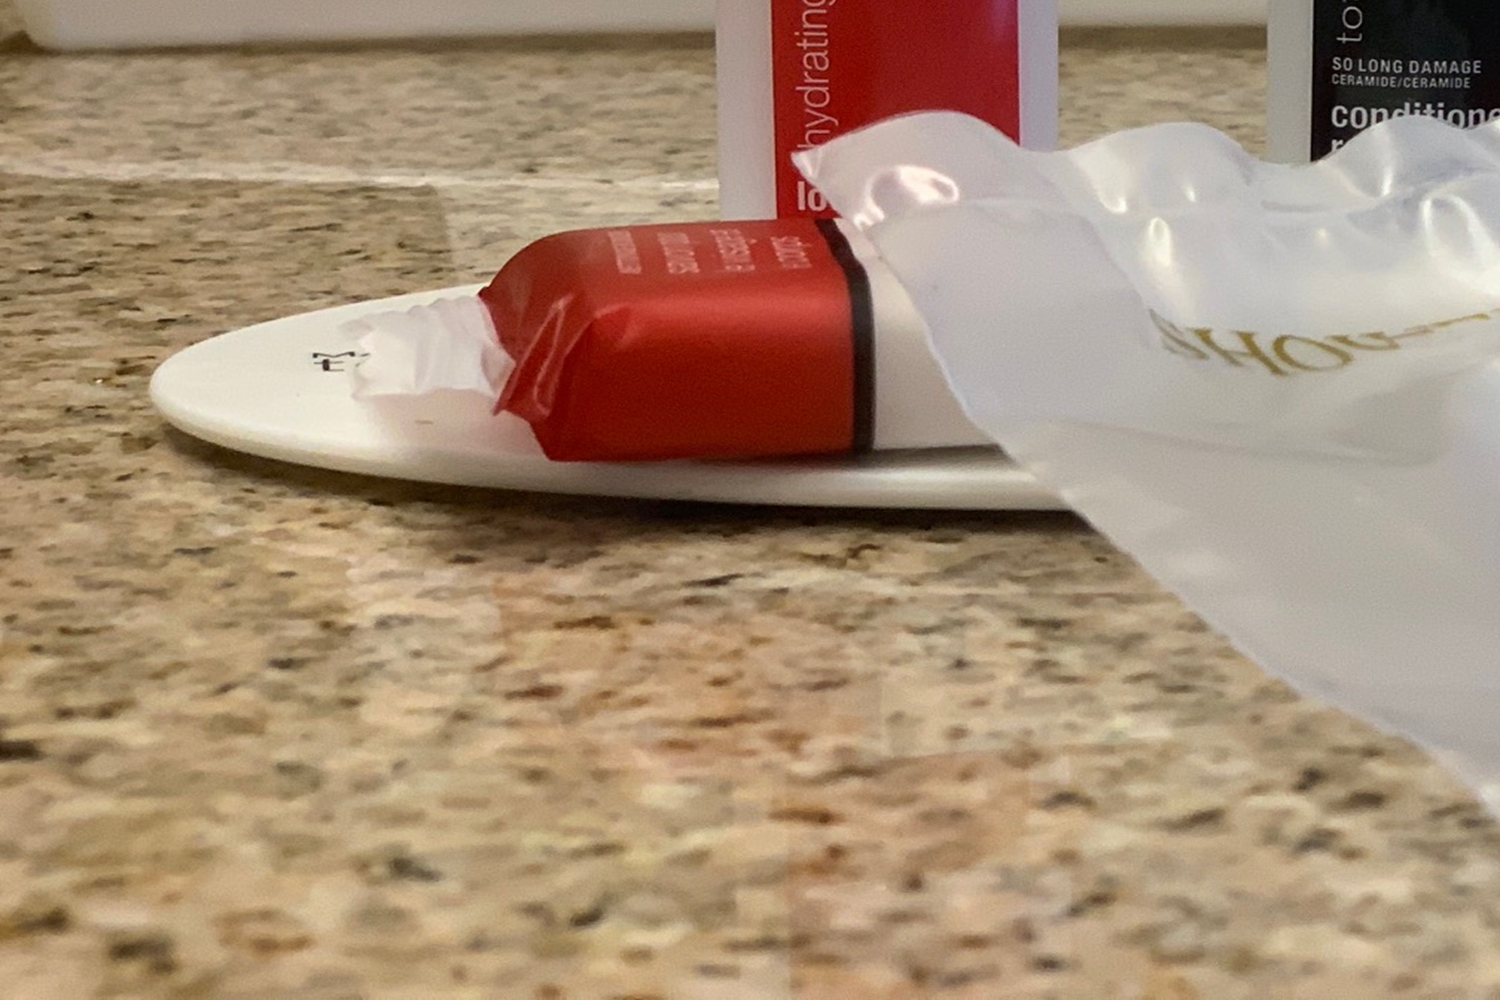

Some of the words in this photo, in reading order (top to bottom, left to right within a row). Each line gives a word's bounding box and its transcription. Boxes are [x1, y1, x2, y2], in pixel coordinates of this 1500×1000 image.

[1331, 56, 1353, 71] SO
[1358, 58, 1403, 74] LONG
[1409, 60, 1482, 74] DAMAGE
